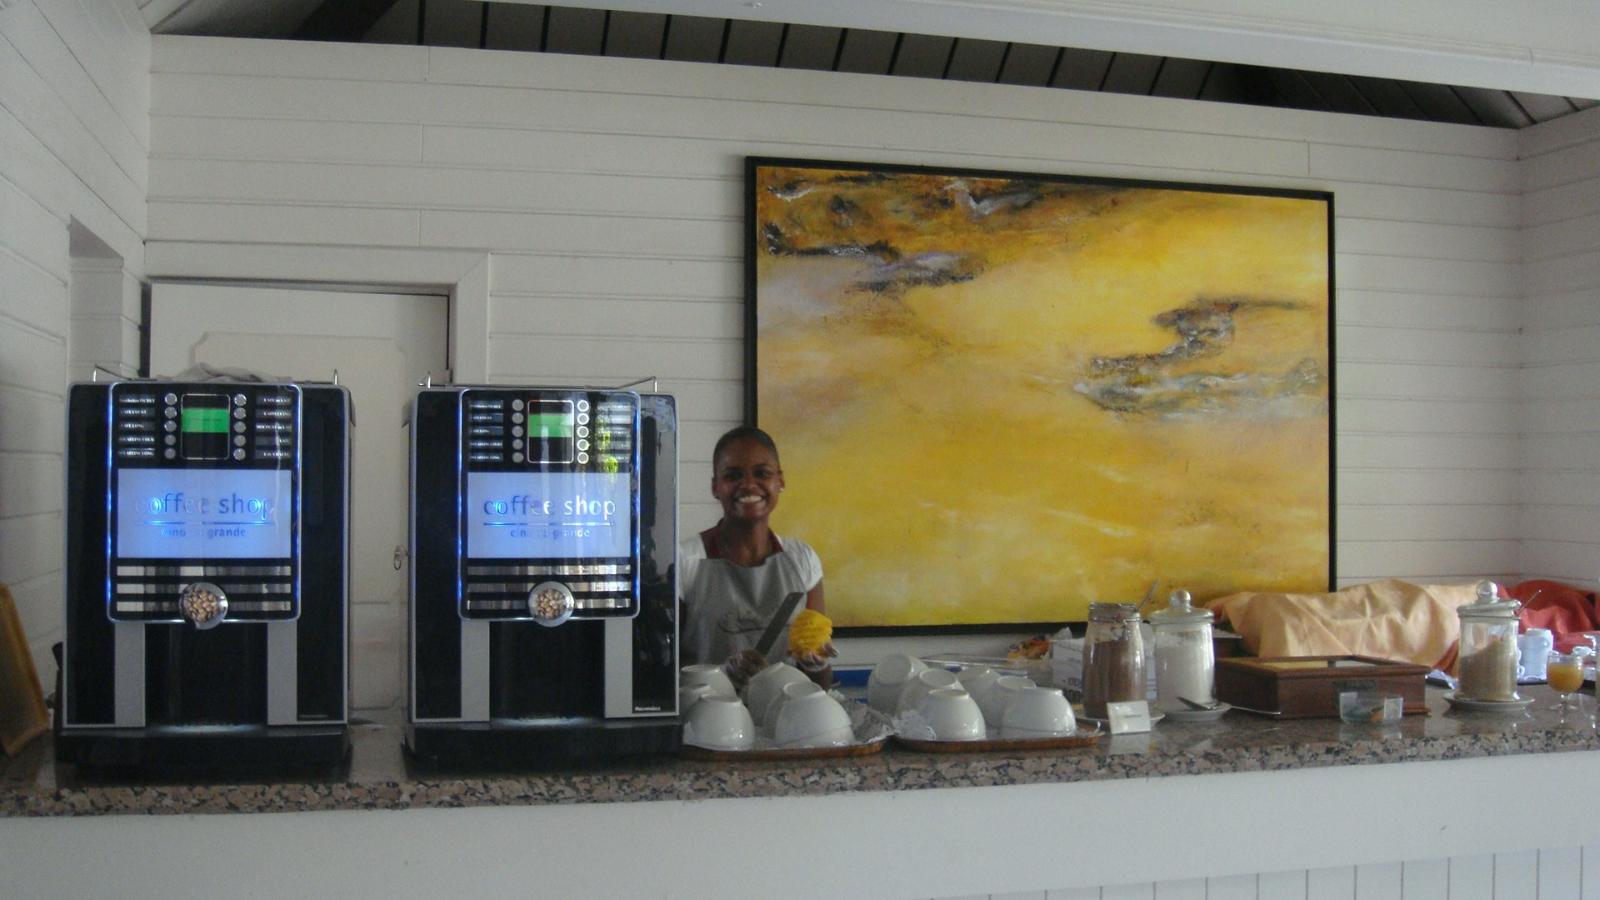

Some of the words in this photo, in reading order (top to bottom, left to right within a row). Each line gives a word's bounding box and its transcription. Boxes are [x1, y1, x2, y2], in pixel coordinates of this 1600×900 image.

[218, 492, 274, 521] shop
[483, 494, 556, 516] coffee
[563, 494, 616, 521] shop
[207, 527, 247, 540] grande
